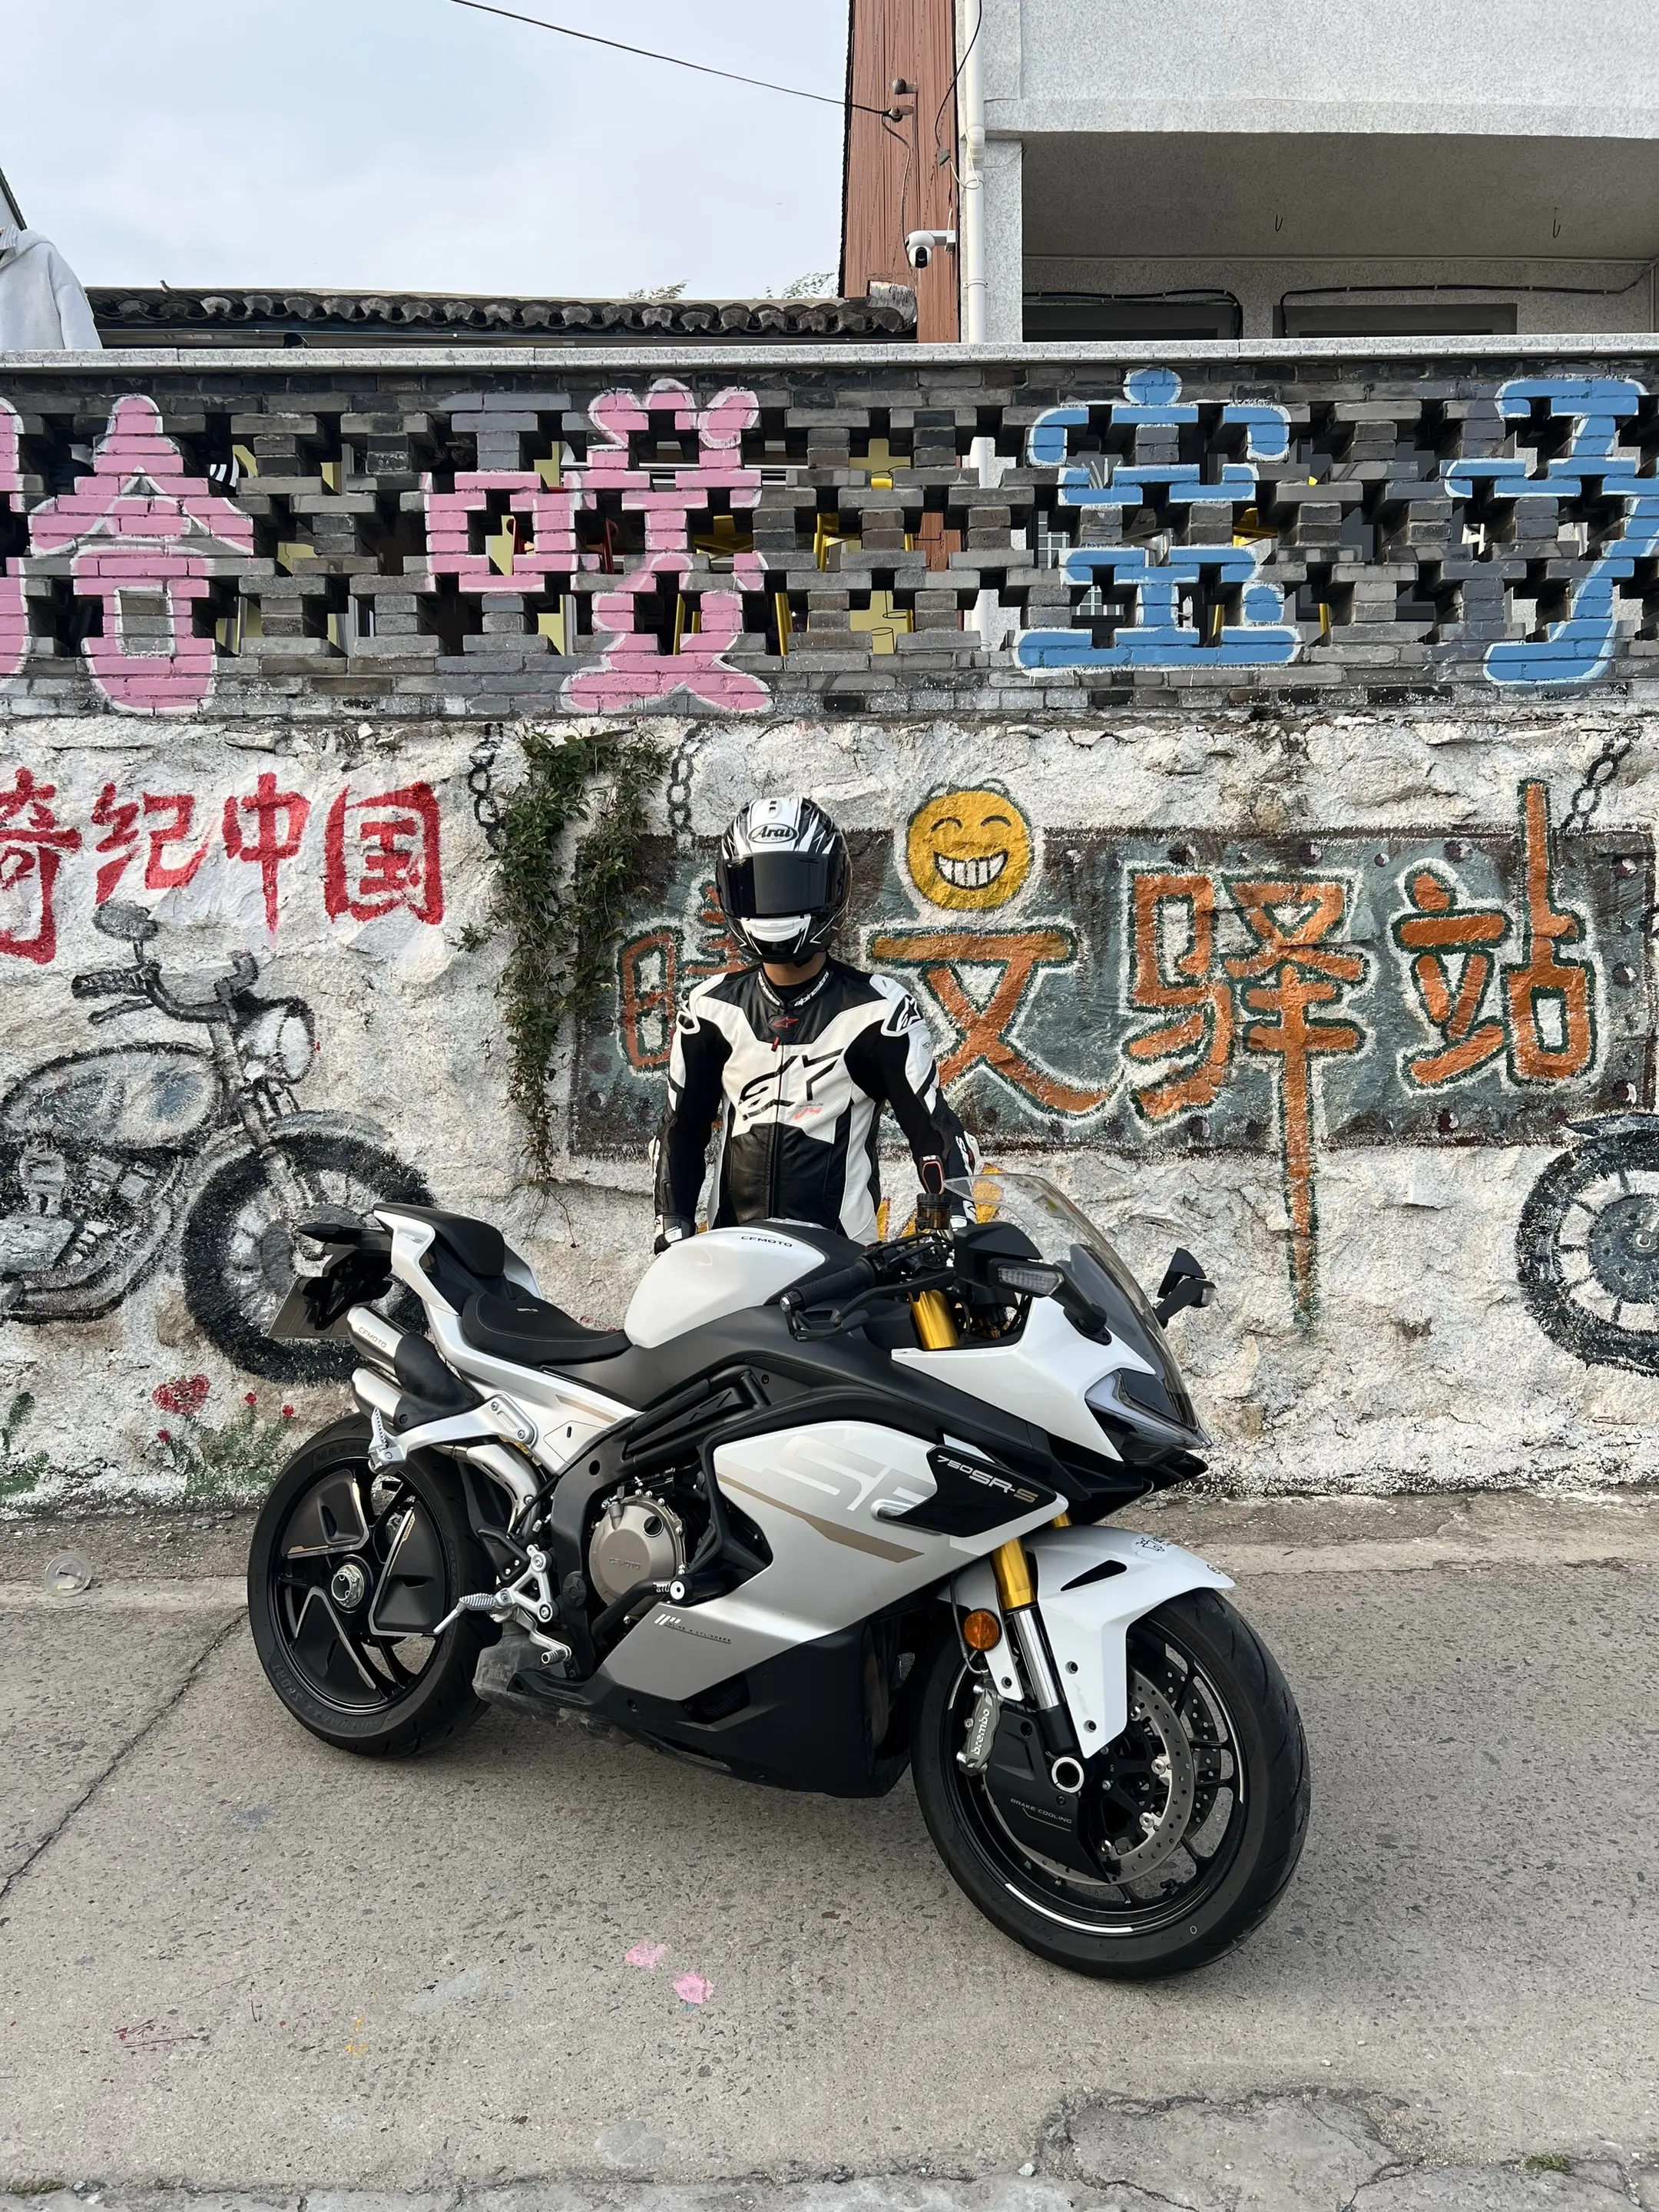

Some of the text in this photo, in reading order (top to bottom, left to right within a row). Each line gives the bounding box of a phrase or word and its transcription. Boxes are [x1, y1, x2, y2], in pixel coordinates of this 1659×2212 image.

[750, 826, 792, 839] Arai
[741, 1236, 793, 1247] CFMOTO
[358, 1326, 387, 1348] CFMOTO
[971, 1708, 990, 1756] brembo
[1010, 1797, 1072, 1824] BRAKE COOLING
